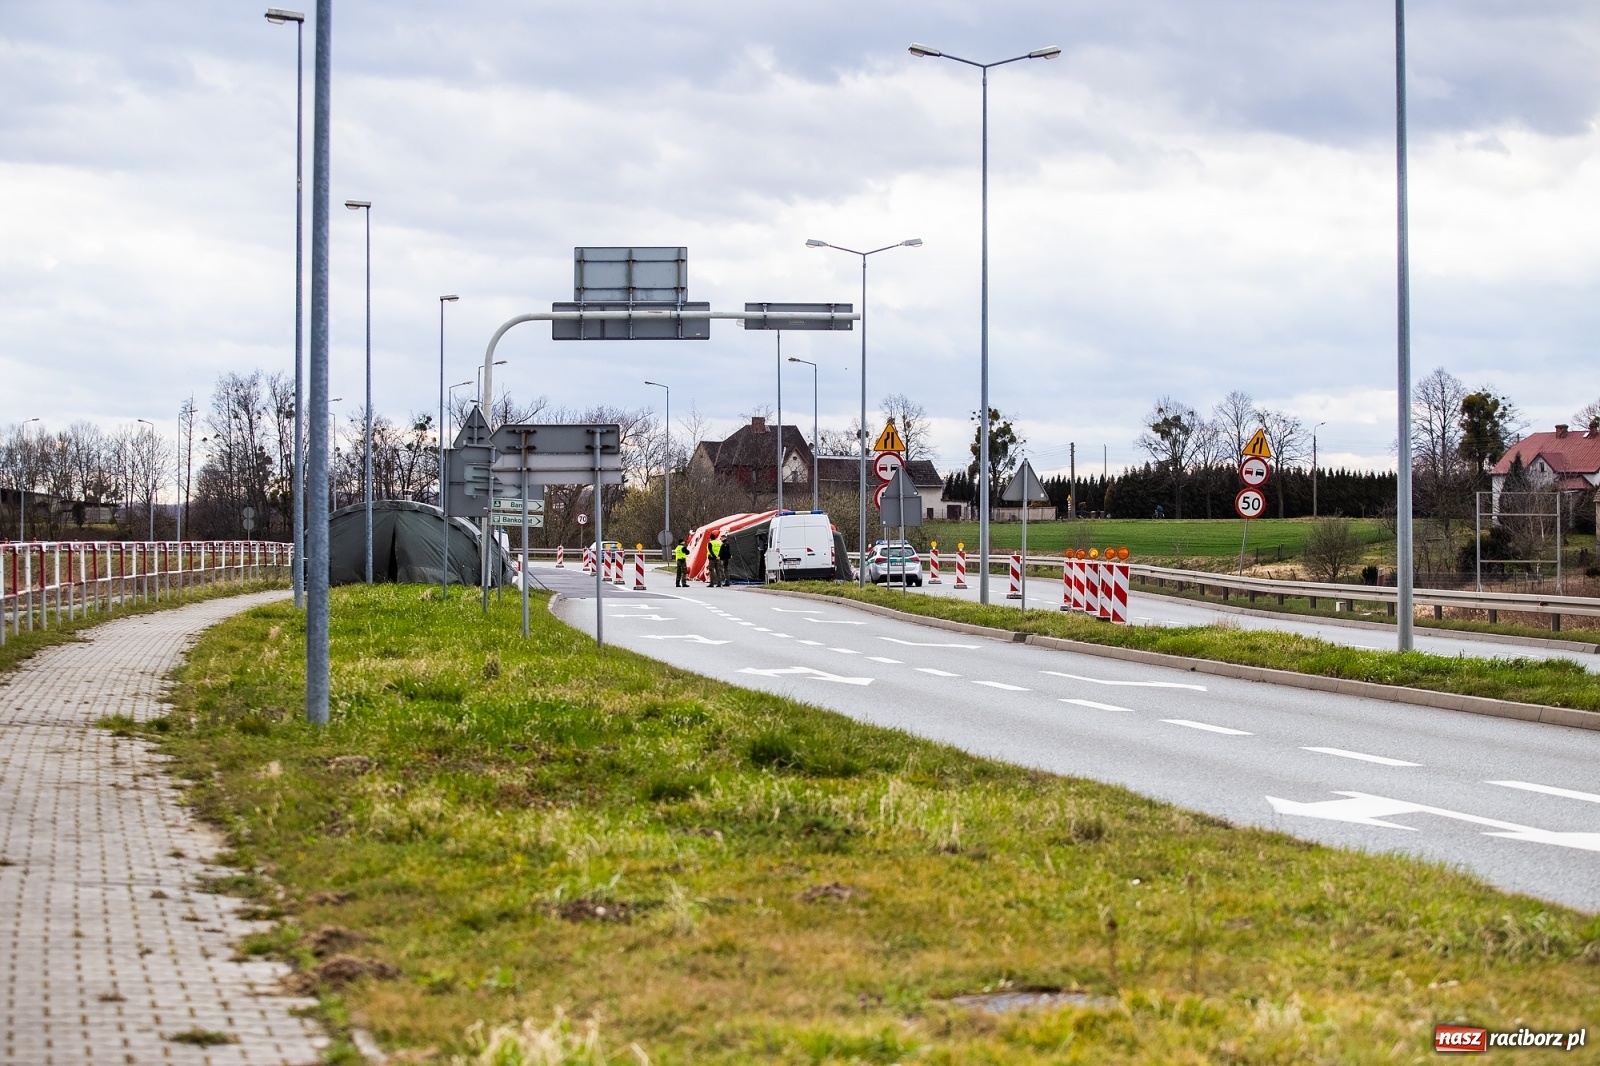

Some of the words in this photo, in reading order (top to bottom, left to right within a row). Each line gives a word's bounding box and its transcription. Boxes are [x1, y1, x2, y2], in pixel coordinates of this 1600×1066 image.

[1241, 496, 1261, 511] 50
[502, 516, 533, 524] Bankoat
[579, 515, 587, 523] 70
